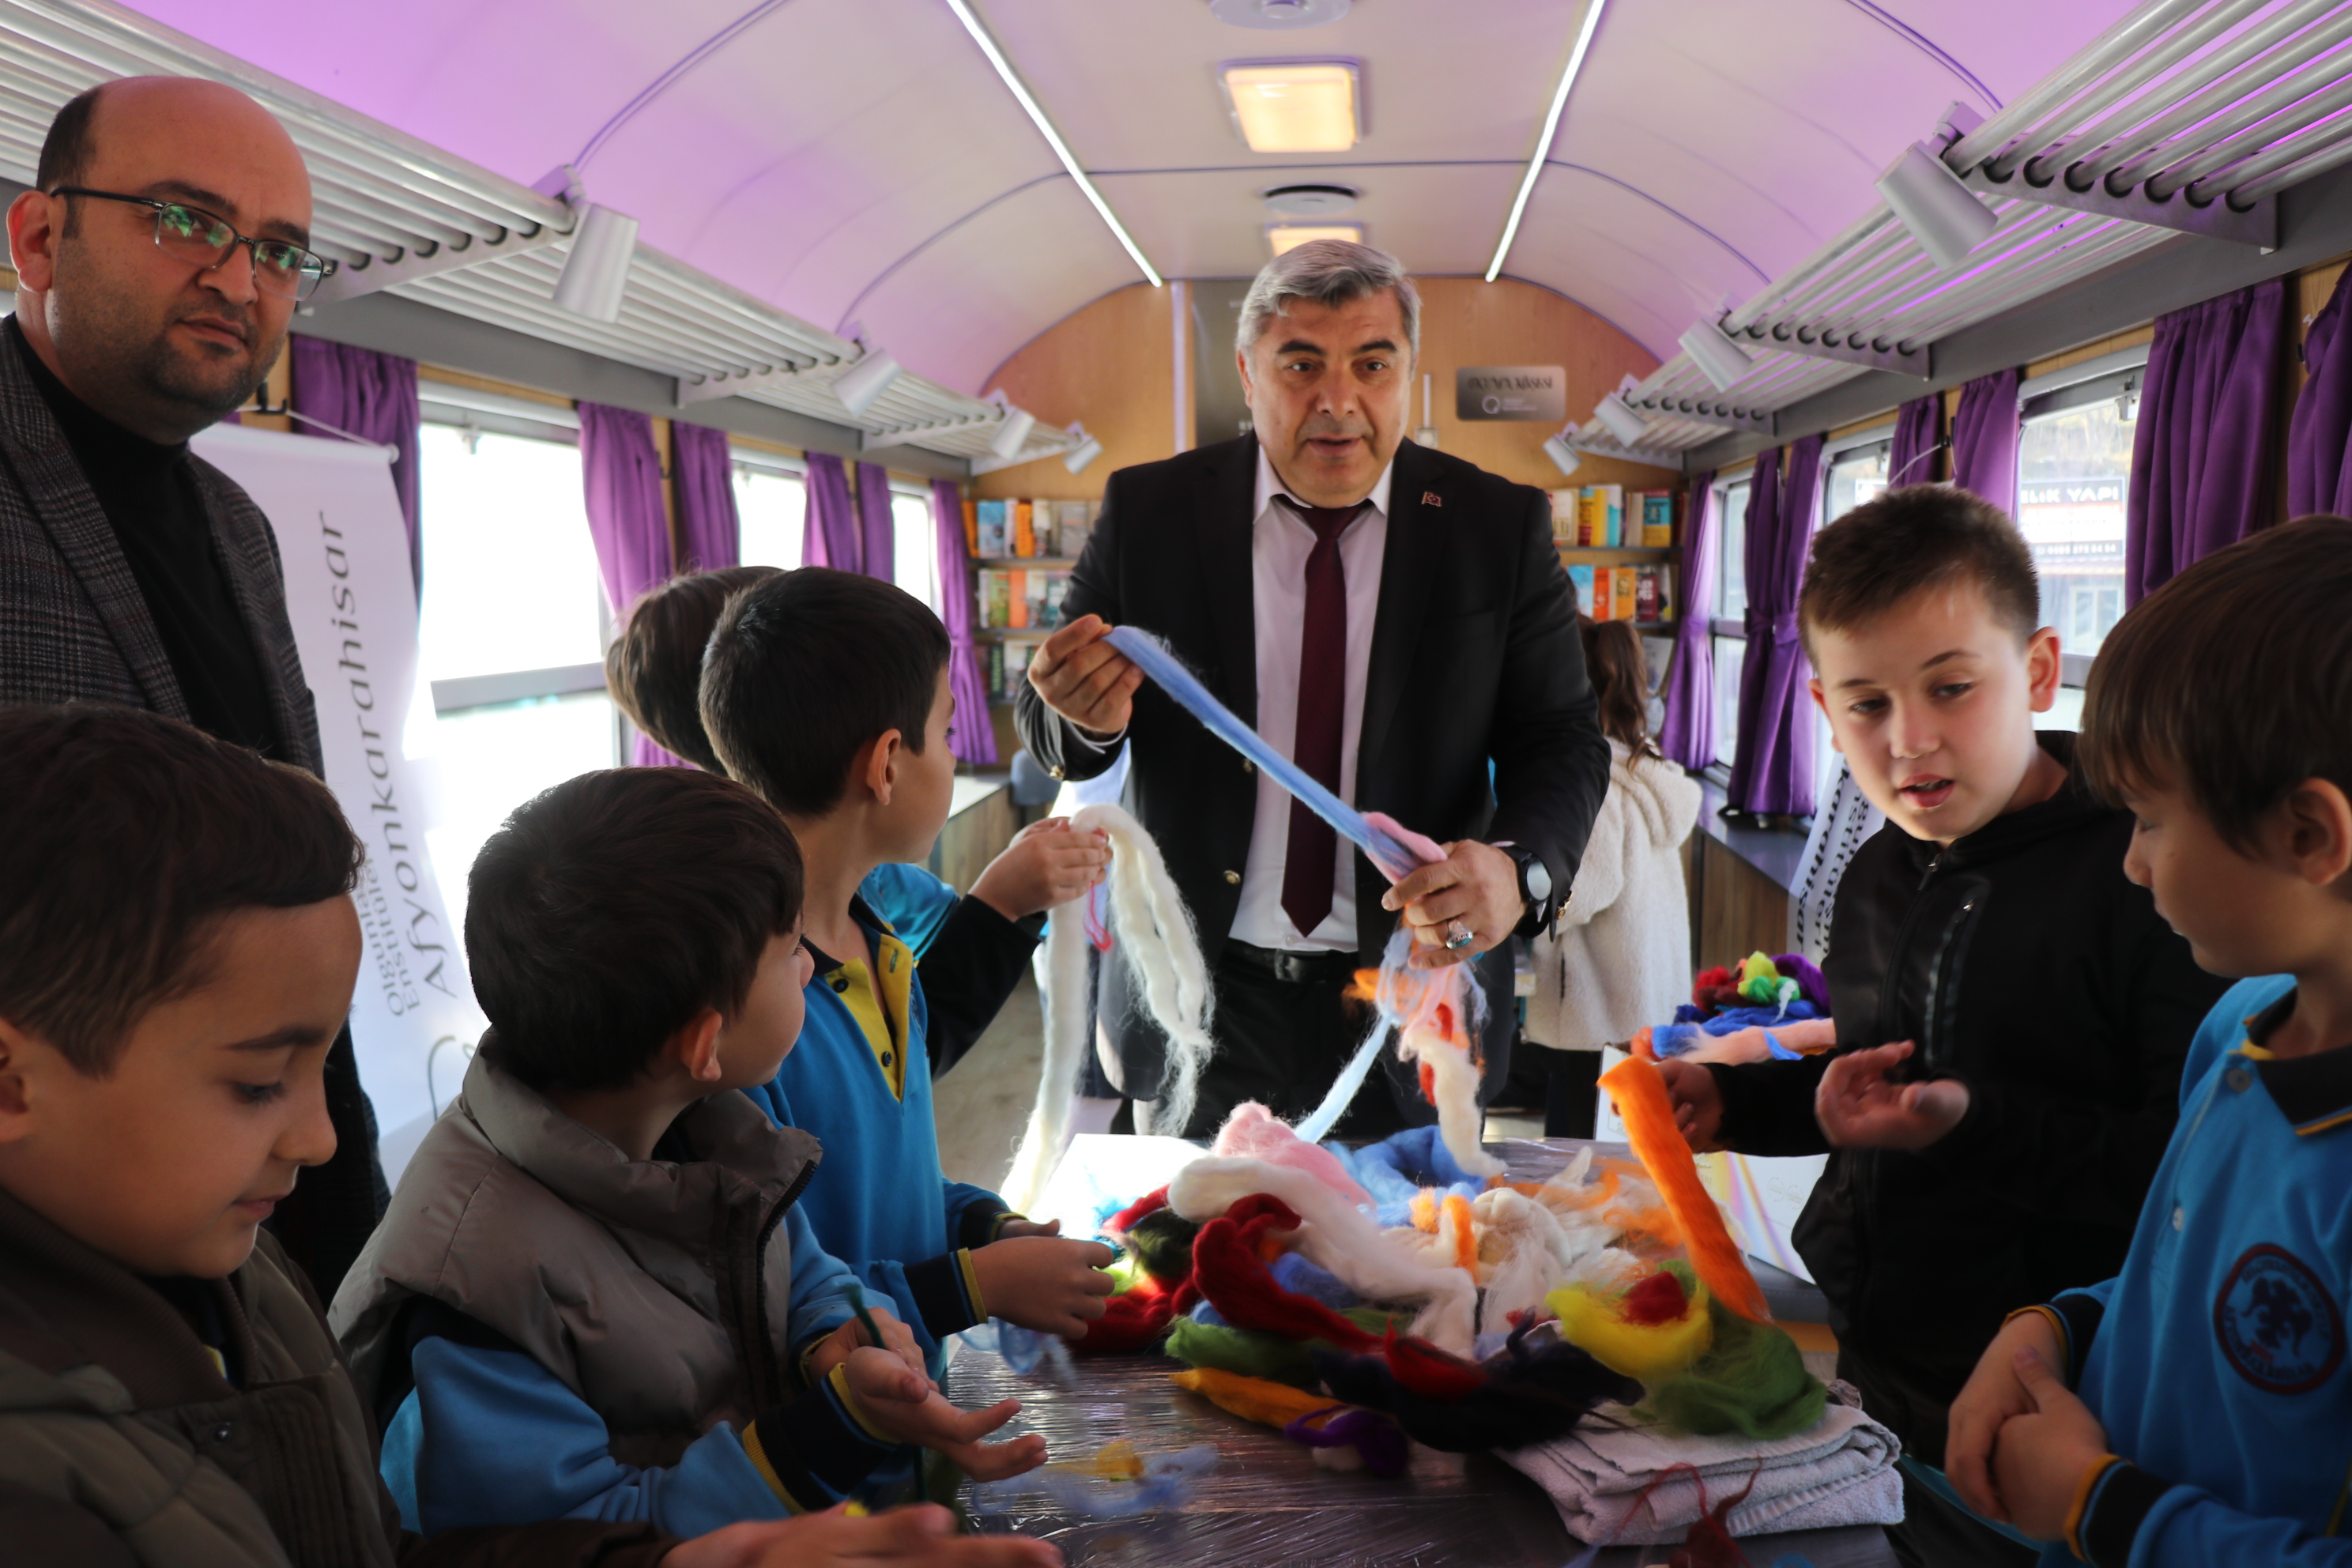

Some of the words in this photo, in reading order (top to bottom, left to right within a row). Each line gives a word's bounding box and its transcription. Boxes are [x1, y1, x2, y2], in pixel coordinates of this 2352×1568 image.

[2067, 486, 2119, 503] YAPI
[318, 511, 458, 998] Afyonkarahisar
[1796, 759, 1849, 954] karahisar
